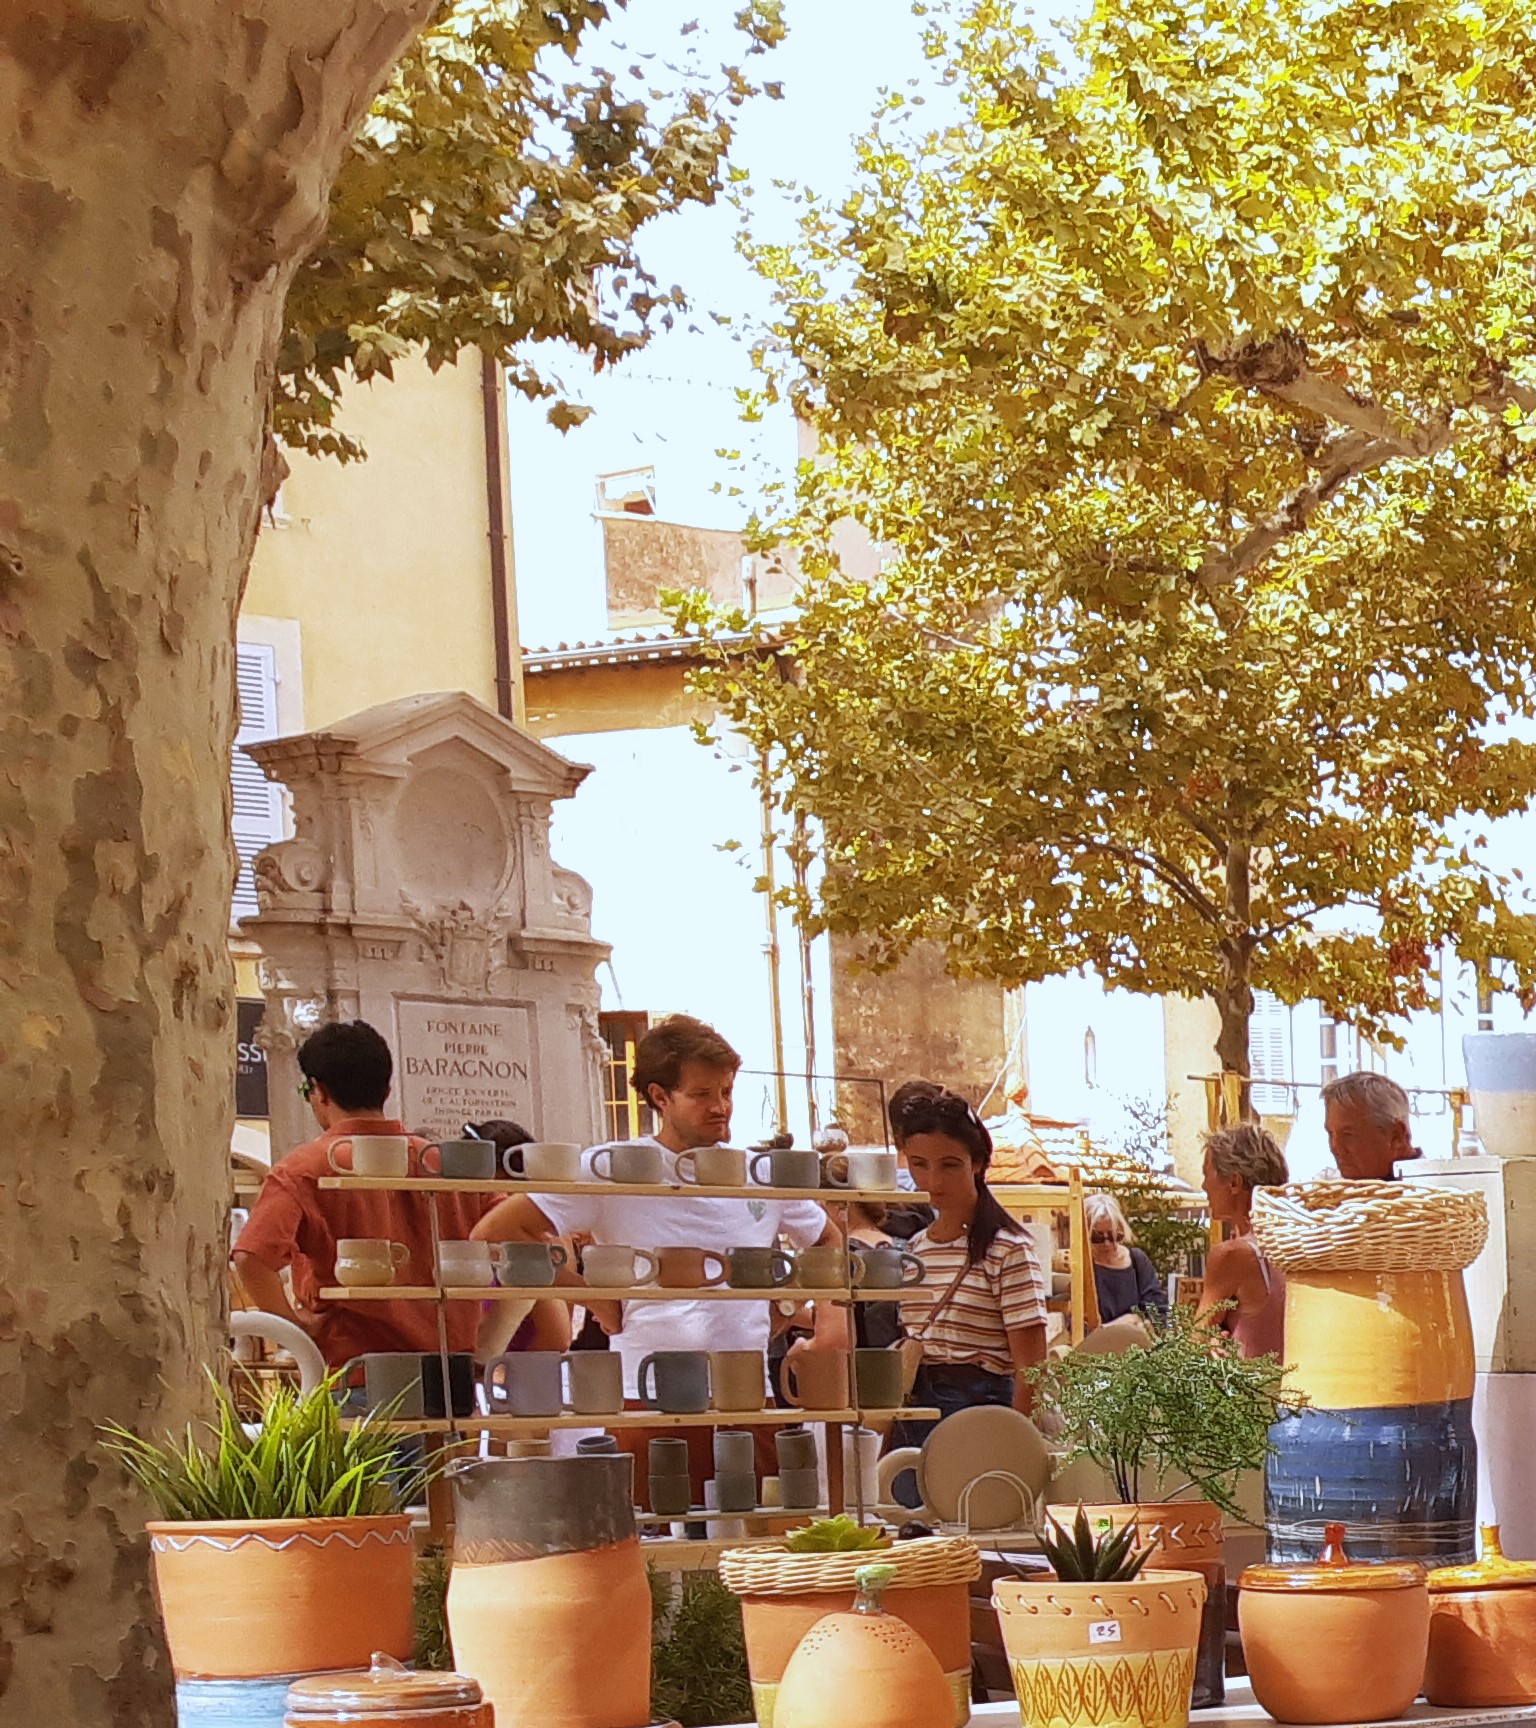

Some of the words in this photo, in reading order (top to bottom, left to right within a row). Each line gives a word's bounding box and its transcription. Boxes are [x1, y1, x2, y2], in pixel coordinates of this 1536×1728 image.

[427, 1020, 502, 1036] FONTAINE
[444, 1042, 488, 1055] PIERRE
[406, 1057, 528, 1080] BARAGNON
[1096, 1624, 1116, 1636] 25
